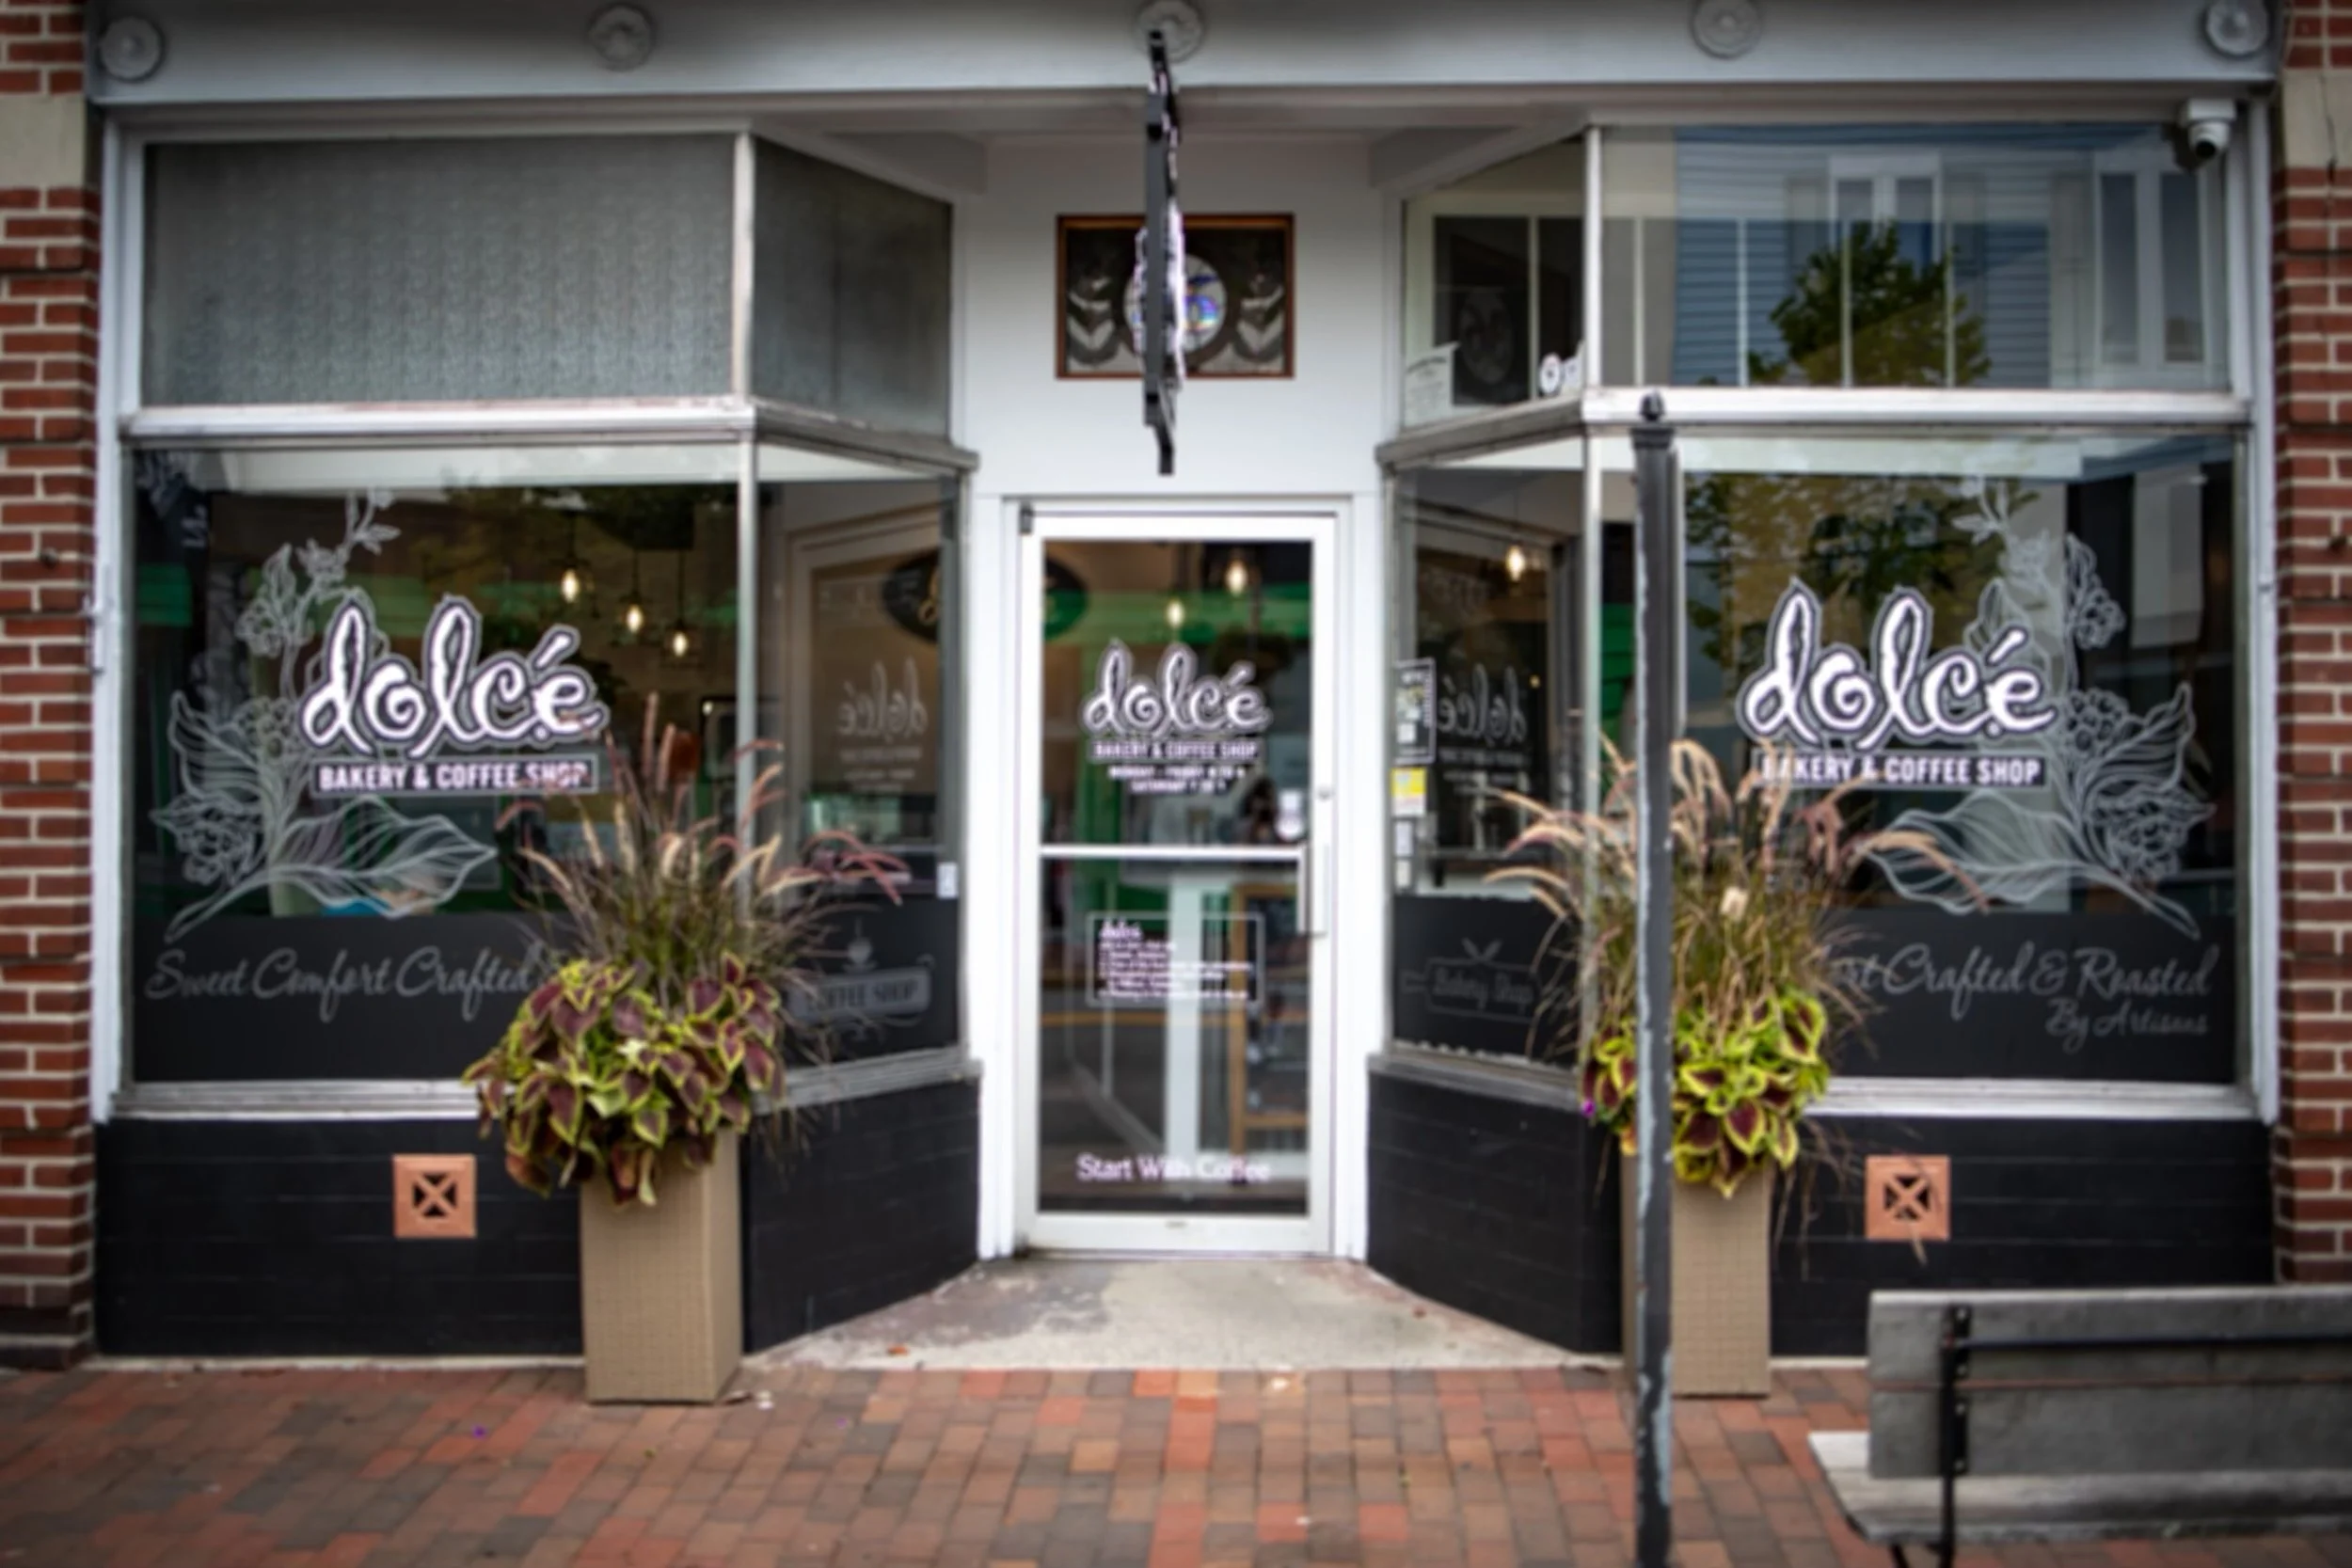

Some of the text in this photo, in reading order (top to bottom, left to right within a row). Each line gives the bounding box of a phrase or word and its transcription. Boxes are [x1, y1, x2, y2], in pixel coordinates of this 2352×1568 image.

[301, 598, 607, 758] dolcé
[1084, 645, 1271, 736] dolcé
[1743, 589, 2059, 752] dolcé
[319, 760, 588, 791] BAKERY & COFFEE SHOP
[1860, 756, 1880, 781] &
[1885, 756, 1970, 785] COFFEE
[1977, 757, 2042, 785] SHOP
[145, 947, 246, 1000] Sweet
[1884, 942, 2036, 1021] Crafted
[2074, 943, 2220, 1000] Roasted
[1077, 1152, 1132, 1181] Start
